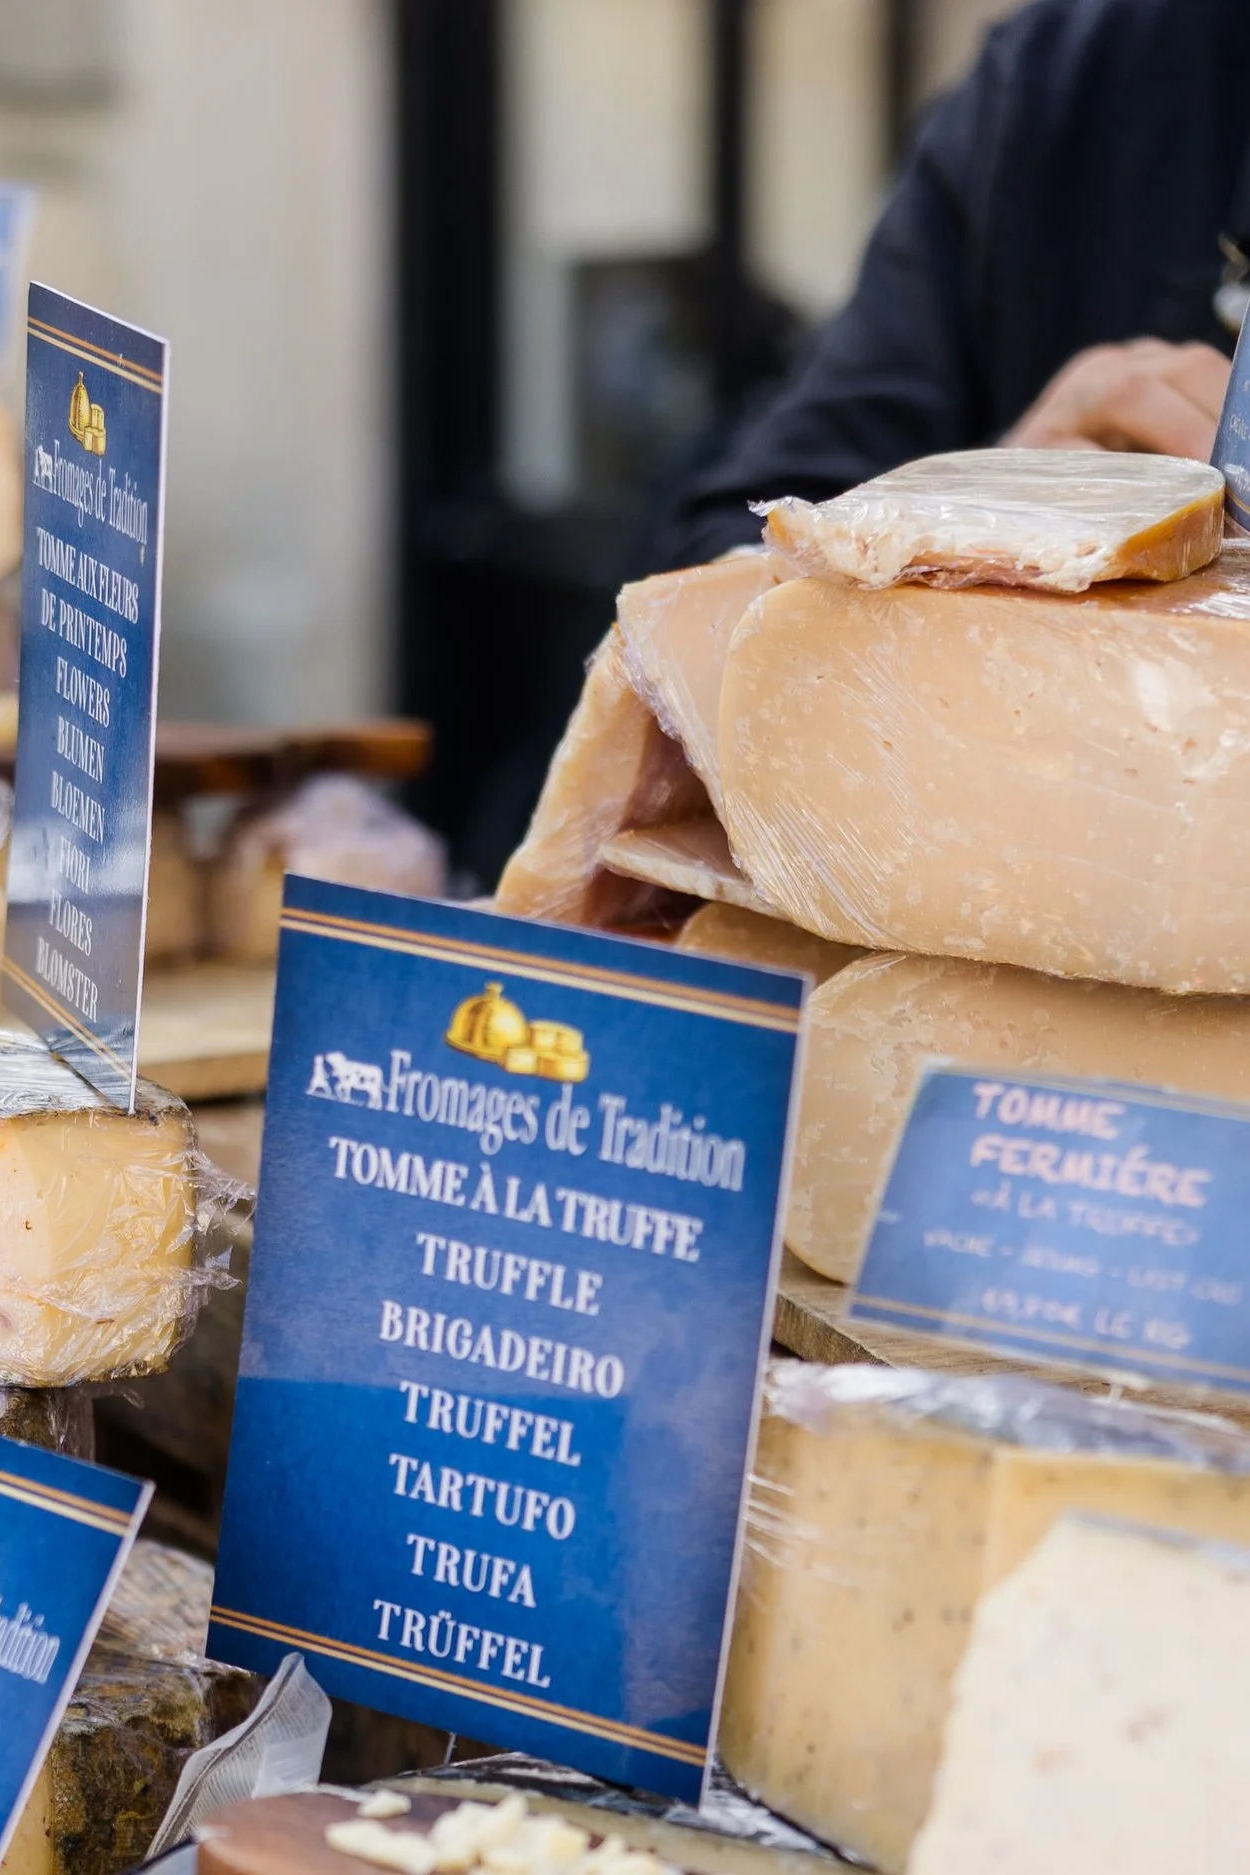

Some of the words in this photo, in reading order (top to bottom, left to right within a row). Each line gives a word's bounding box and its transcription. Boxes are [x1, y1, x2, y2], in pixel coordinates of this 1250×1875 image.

[53, 439, 94, 528] Fromages
[95, 458, 107, 523] de
[109, 466, 148, 546] Tradition
[36, 526, 77, 585] TOMME
[77, 551, 99, 600] AUX
[99, 563, 139, 625] FLEURS
[41, 587, 57, 632] DE
[59, 599, 128, 678] PRINTEMPS
[56, 655, 110, 729] FLOWERS
[56, 715, 105, 785] BLUMEN
[50, 769, 106, 846] BLOEMEN
[59, 836, 92, 896] FIORI
[49, 888, 93, 957] FLORES
[36, 935, 99, 1024] BLOMSTER
[384, 1048, 540, 1156] Fromages
[545, 1081, 592, 1157] de
[597, 1091, 747, 1192] Tradition
[971, 1081, 1128, 1141] TOMME
[329, 1135, 469, 1208] TOMME
[470, 1161, 499, 1215] À
[504, 1175, 552, 1228] LA
[555, 1186, 704, 1263] TRUFFE
[415, 1231, 603, 1317] TRUFFLE
[378, 1299, 625, 1399] BRIGADEIRO
[399, 1379, 582, 1467] TRUFFEL
[388, 1452, 576, 1540] TARTUFO
[406, 1532, 537, 1609] TRUFA
[372, 1598, 551, 1689] TRÜFFEL
